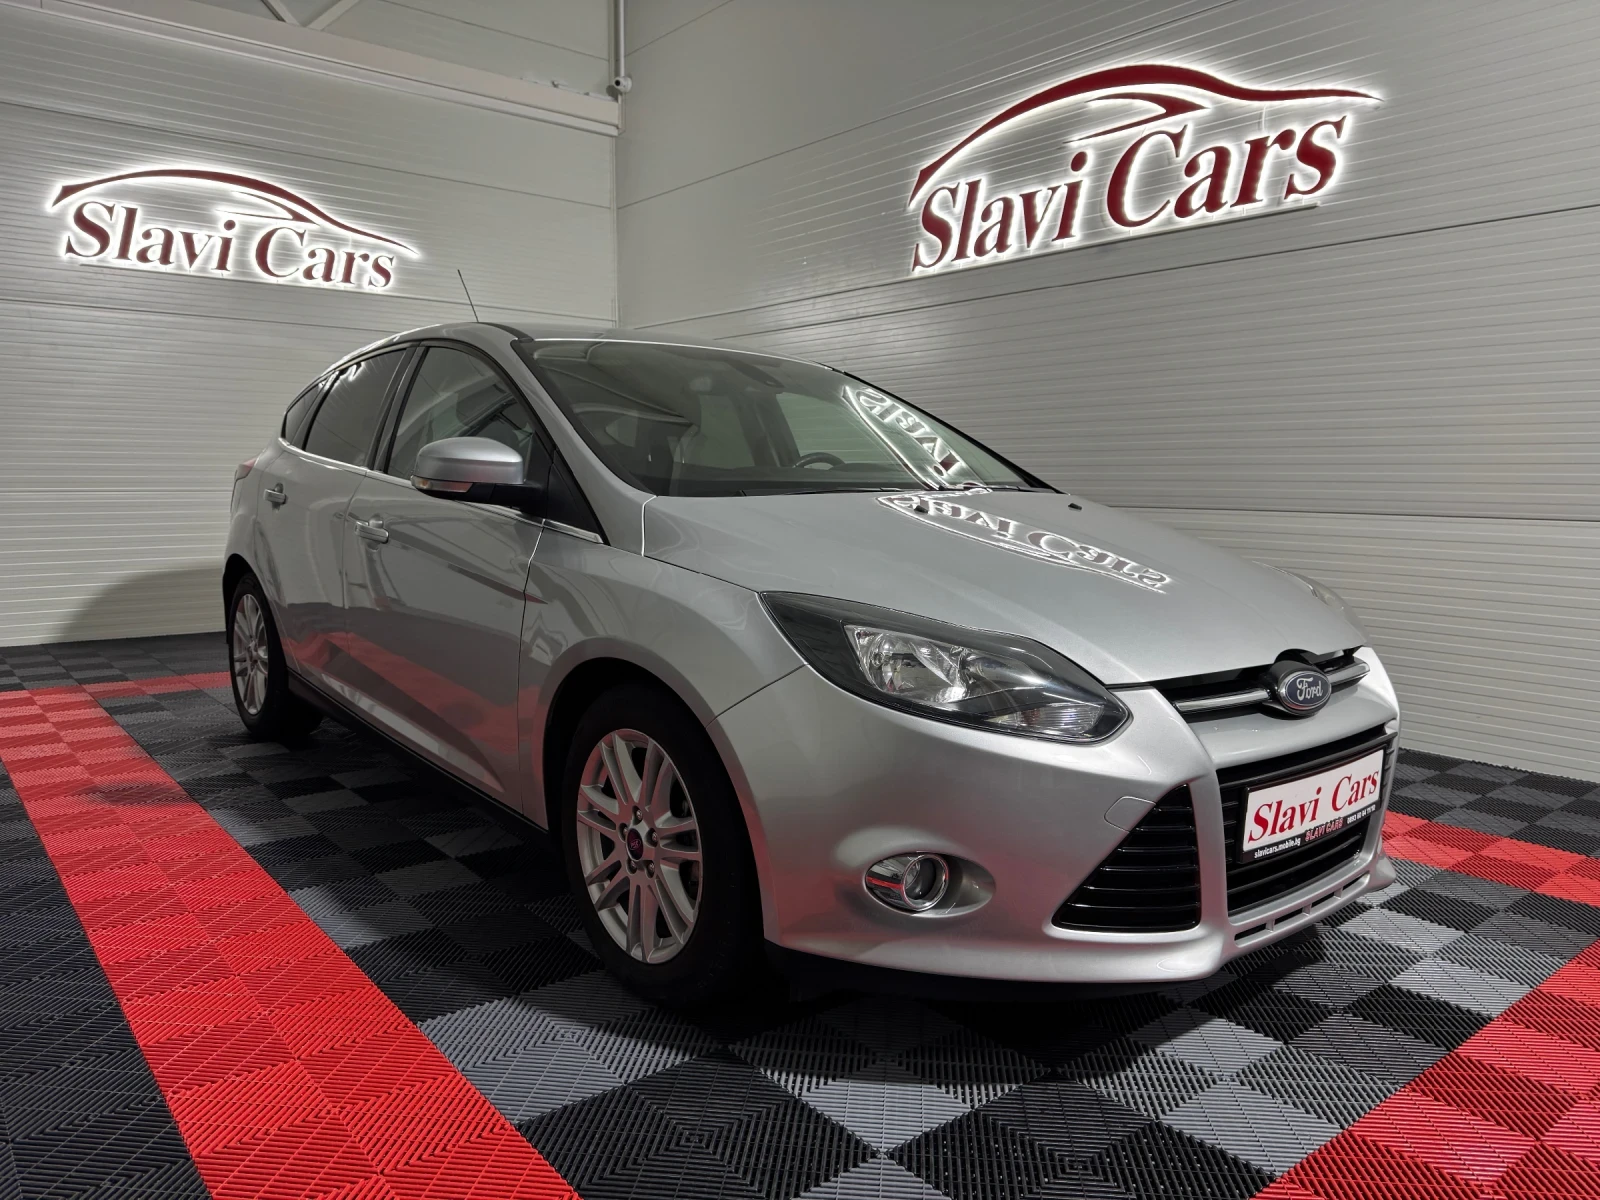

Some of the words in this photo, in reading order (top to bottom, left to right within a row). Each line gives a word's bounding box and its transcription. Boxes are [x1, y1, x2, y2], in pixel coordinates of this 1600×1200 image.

[911, 151, 1088, 272] Slavi
[1106, 115, 1348, 228] Cars
[64, 201, 237, 272] Slavi
[255, 226, 395, 288] Cars
[1296, 677, 1324, 701] Ford
[1248, 787, 1322, 843] Slavi
[1331, 770, 1379, 812] Cars
[1254, 836, 1302, 858] slavicars.mobile.bg
[1305, 824, 1326, 841] SLAVI
[1326, 816, 1344, 833] CARS
